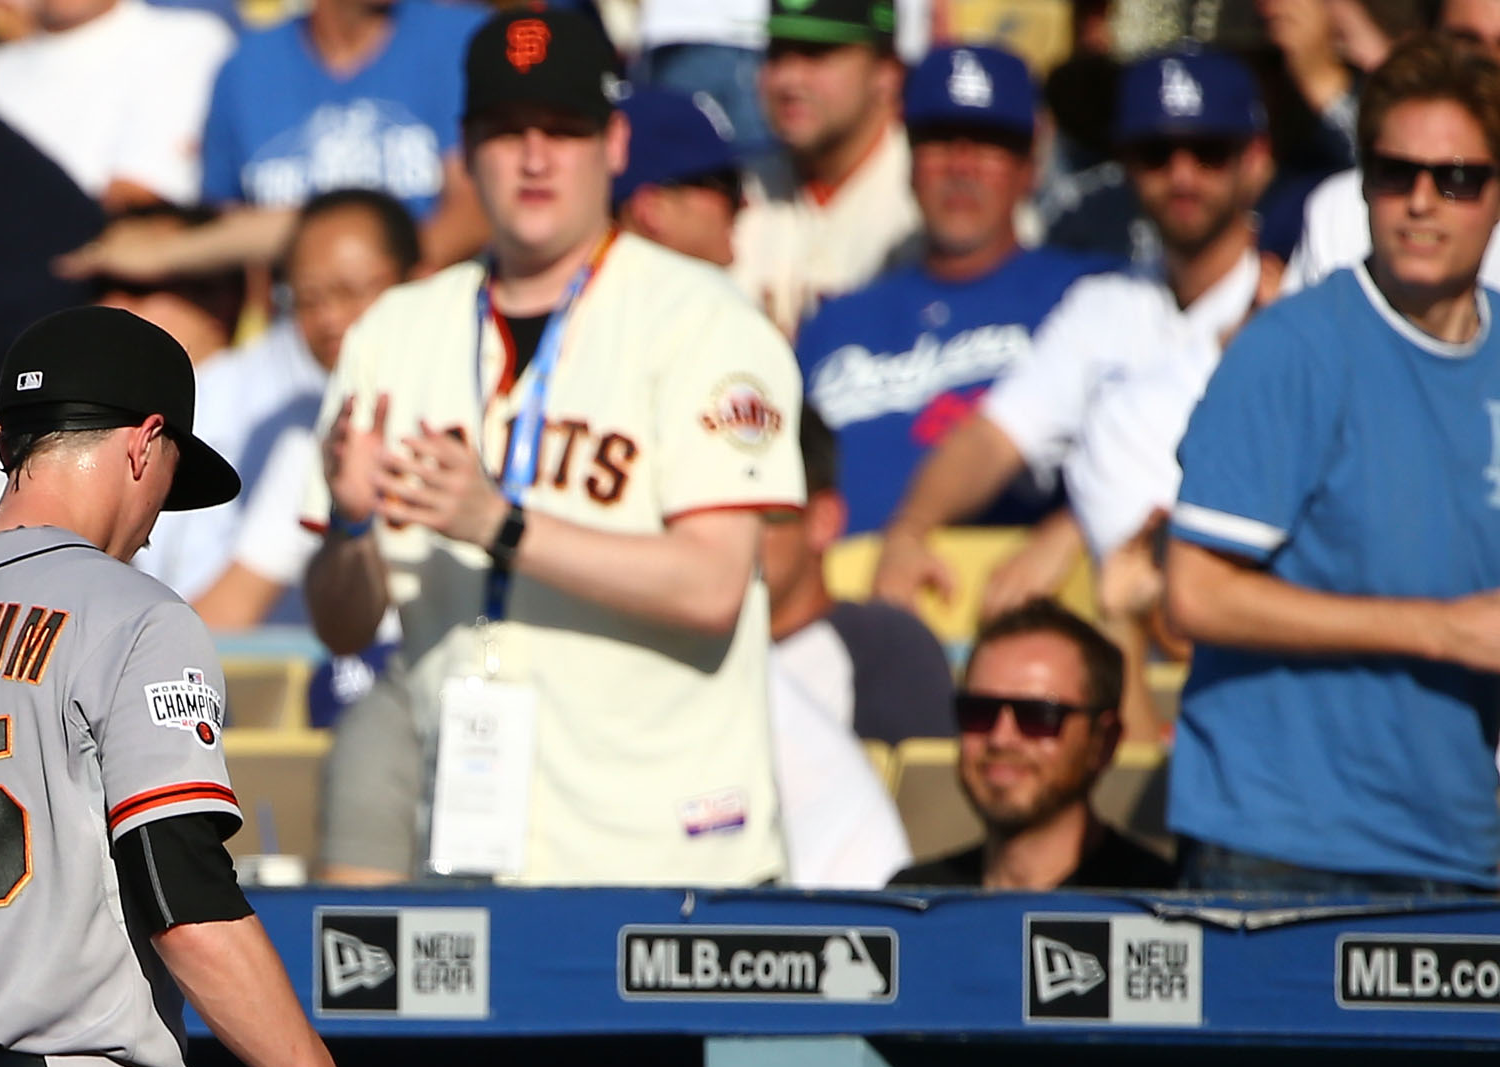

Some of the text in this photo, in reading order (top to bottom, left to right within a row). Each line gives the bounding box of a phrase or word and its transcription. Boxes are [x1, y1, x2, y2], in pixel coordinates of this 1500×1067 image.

[150, 685, 193, 694] WORLD
[414, 932, 476, 959] NEW
[1127, 940, 1188, 967] NEW
[414, 960, 475, 994] ERA
[630, 938, 817, 989] MLB.com
[1349, 947, 1500, 998] MLB.co
[1127, 967, 1187, 1000] ERA
